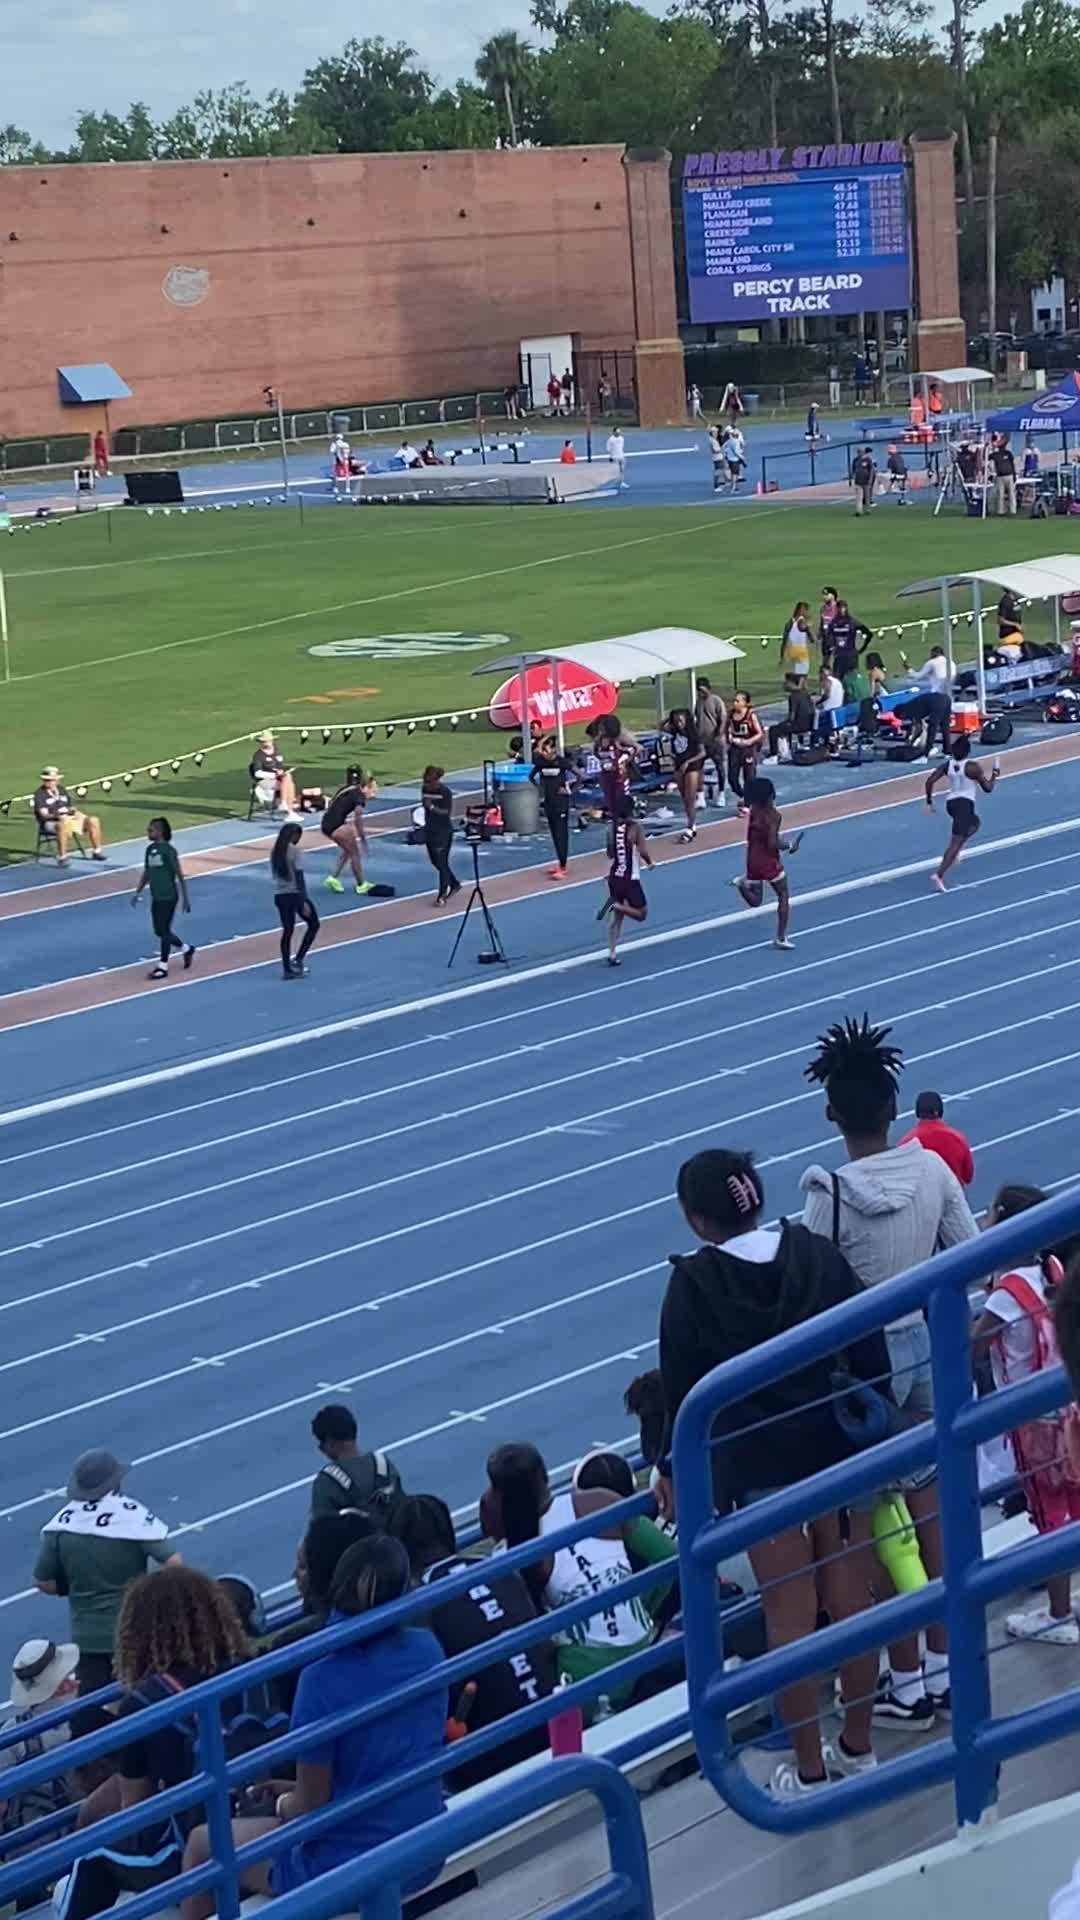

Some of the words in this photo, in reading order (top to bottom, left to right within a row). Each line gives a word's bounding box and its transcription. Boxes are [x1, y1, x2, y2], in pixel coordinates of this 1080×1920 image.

[684, 148, 785, 176] PRESSLY
[792, 141, 902, 169] STADIUM
[762, 244, 782, 253] CITY
[706, 266, 735, 276] CORAL
[733, 278, 794, 297] PERCY
[798, 273, 863, 292] BEARD
[766, 294, 831, 313] TRACK
[1020, 417, 1061, 430] FLORIDA
